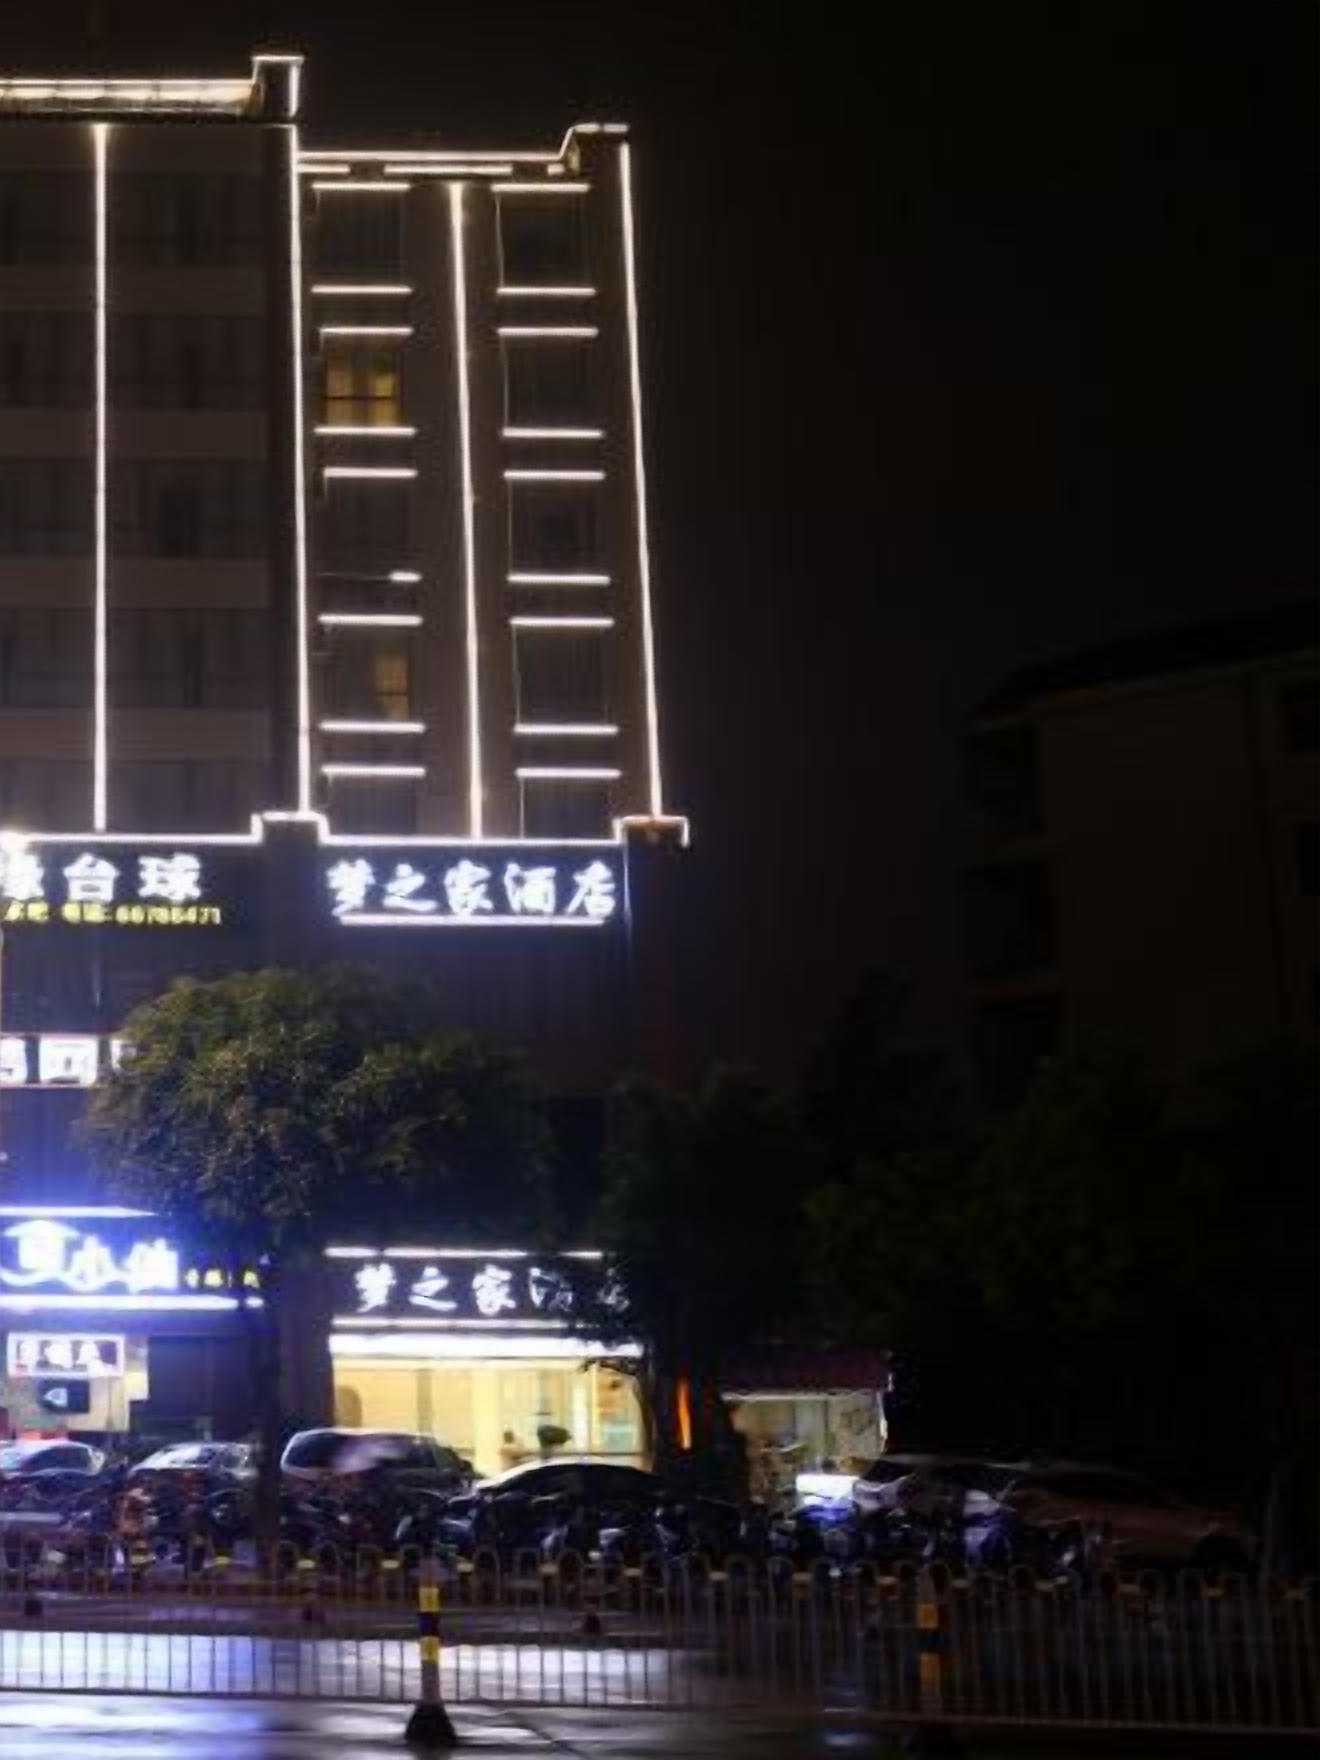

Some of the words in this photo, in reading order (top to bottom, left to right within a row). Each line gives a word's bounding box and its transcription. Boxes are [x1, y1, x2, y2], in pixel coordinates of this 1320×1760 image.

[326, 859, 615, 916] 梦之家酒店
